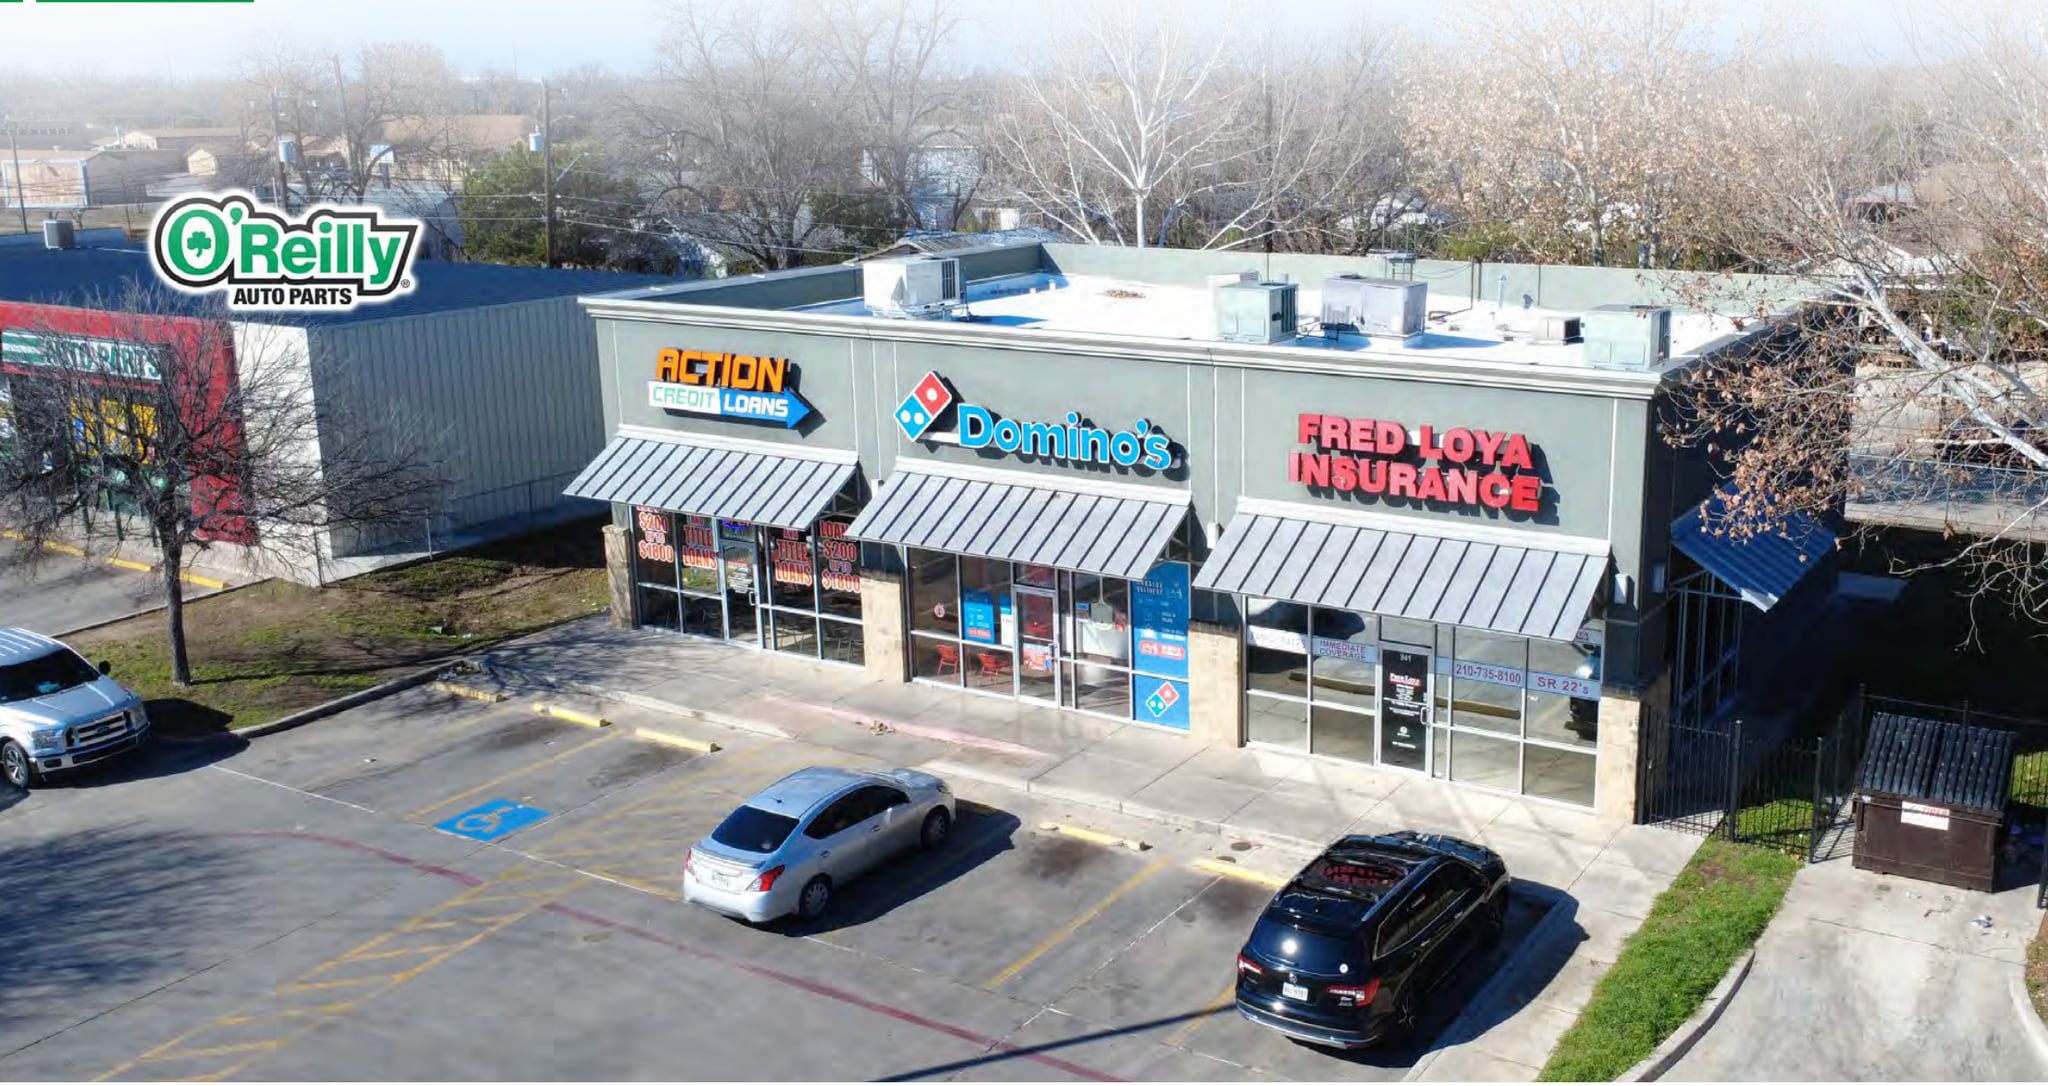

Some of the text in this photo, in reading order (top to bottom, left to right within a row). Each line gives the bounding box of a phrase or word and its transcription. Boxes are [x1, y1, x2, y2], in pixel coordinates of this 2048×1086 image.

[656, 347, 786, 392] ACTION
[652, 386, 788, 417] CREDIT LOANS
[957, 402, 1172, 471] Domino's
[1298, 413, 1533, 469] FRED LOYA
[1288, 452, 1542, 512] INSURANCE
[639, 511, 669, 533] $200
[683, 524, 713, 548] TITLE
[682, 545, 718, 570] LOANS
[776, 539, 808, 562] TITLE
[823, 540, 857, 562] $200
[775, 560, 813, 586] LOANS
[821, 568, 861, 593] $1800
[1319, 647, 1366, 660] COVERAGE
[1320, 640, 1366, 654] IMMEDIATE
[1455, 663, 1521, 684] 210-735-8100
[1537, 676, 1590, 695] SR 22's
